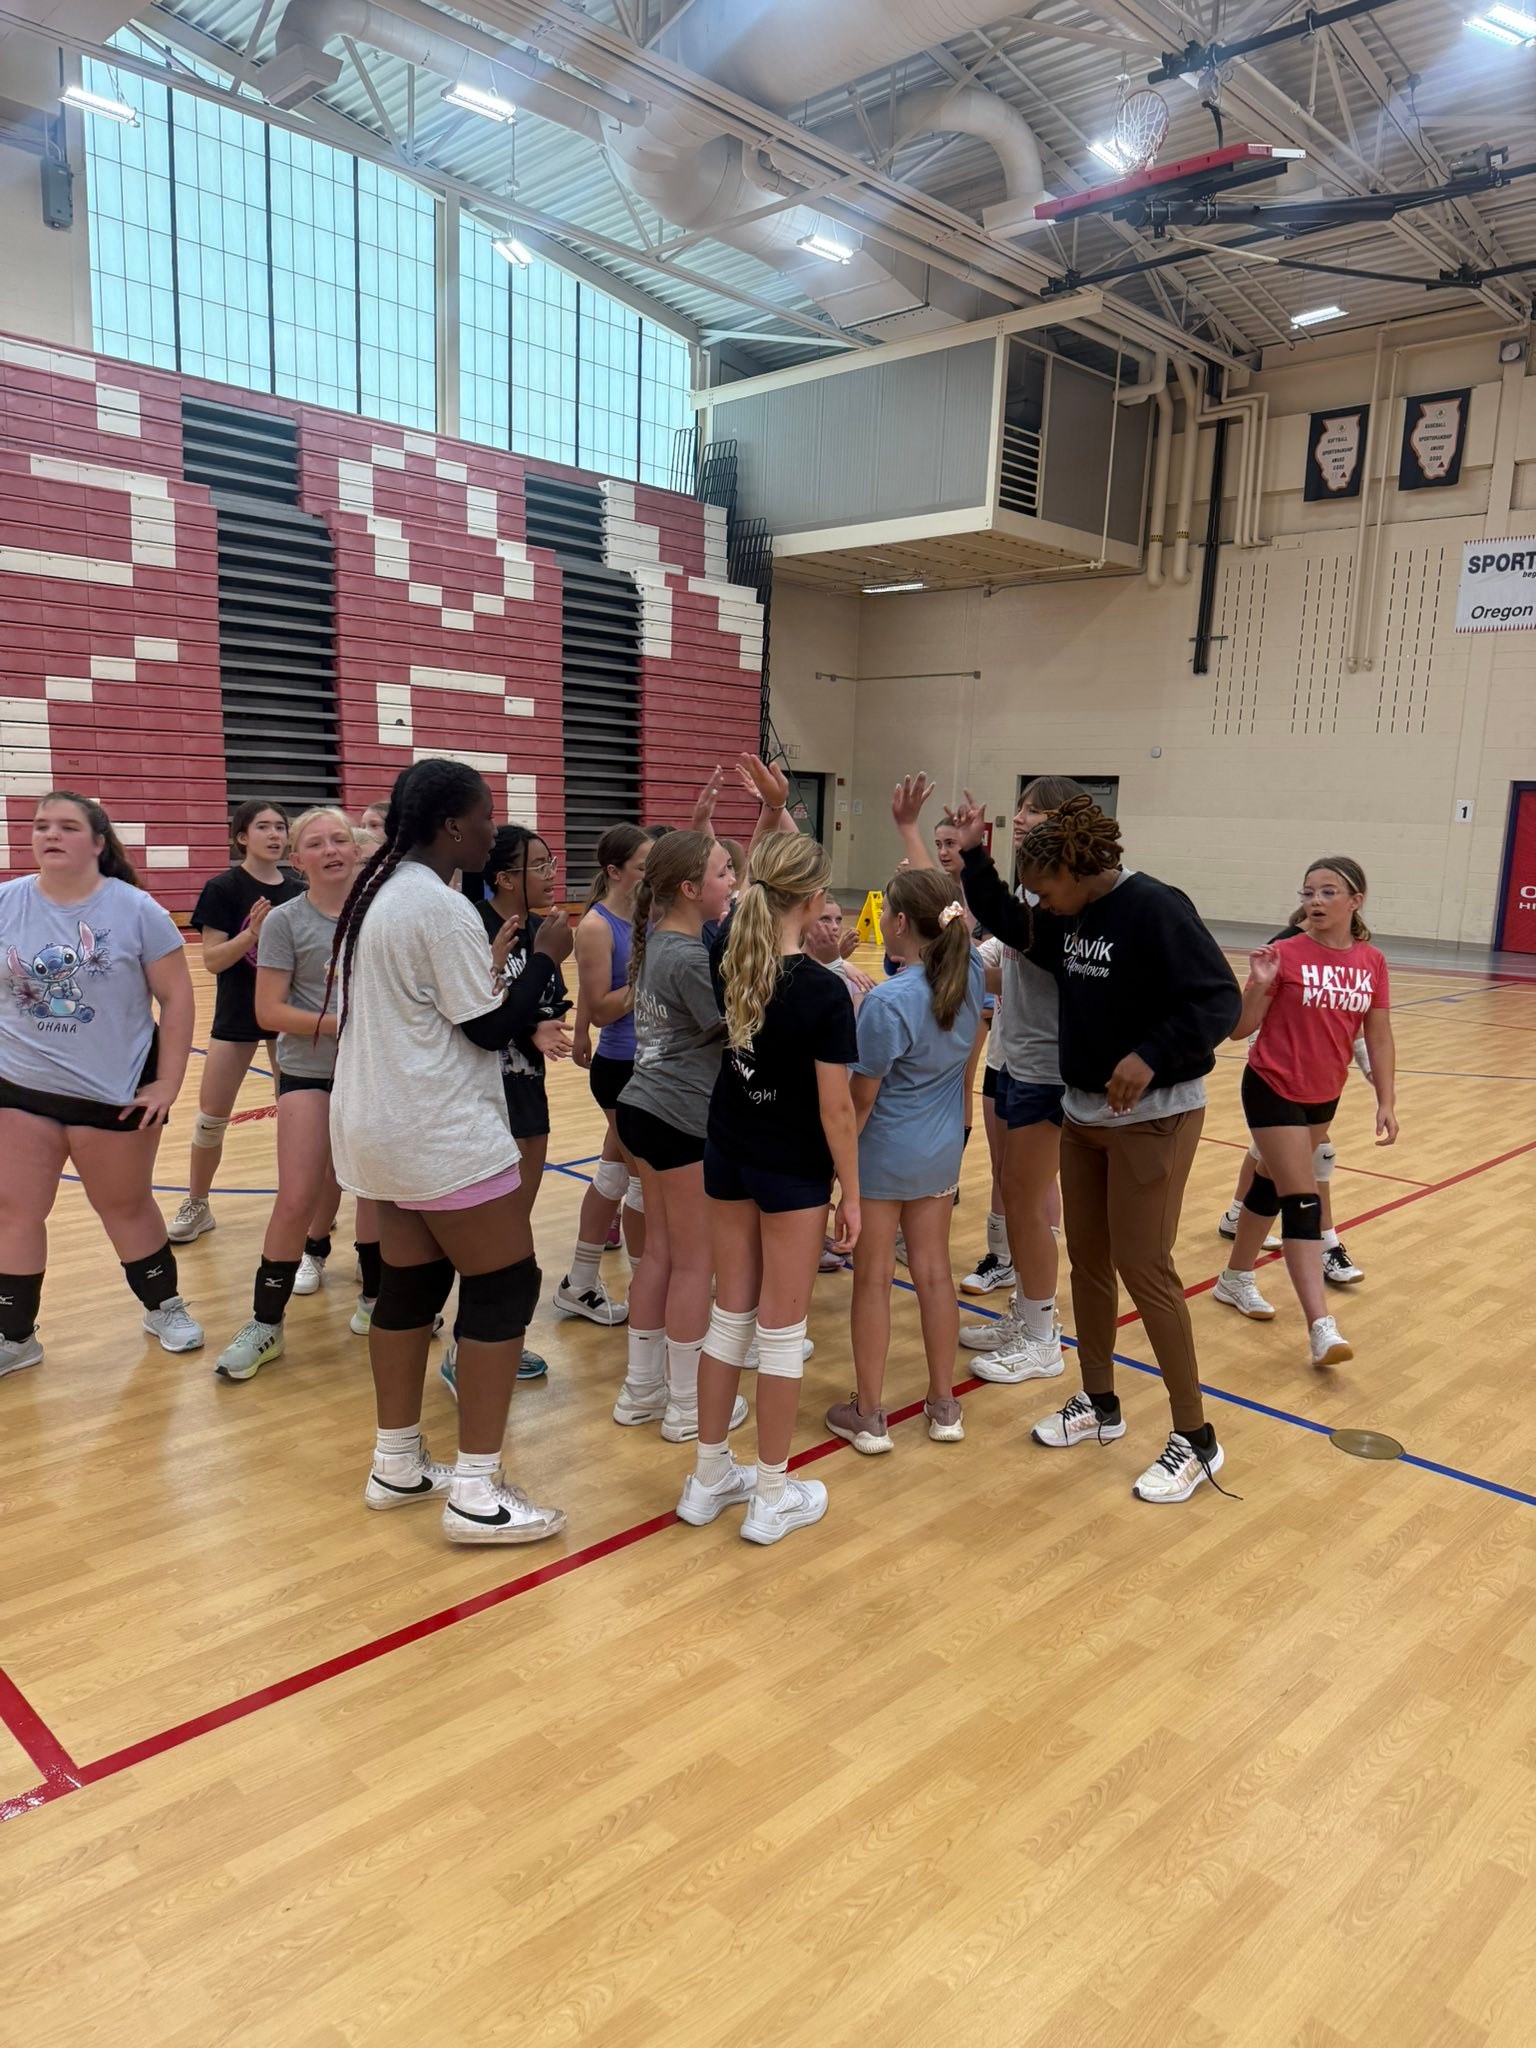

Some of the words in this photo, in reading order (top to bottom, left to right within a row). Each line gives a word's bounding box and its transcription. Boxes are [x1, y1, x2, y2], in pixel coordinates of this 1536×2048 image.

[1418, 434, 1453, 442] SPORTSMANSHIP
[1321, 446, 1354, 456] SPORTSMANSHIP
[1470, 605, 1533, 622] Oregon
[1461, 805, 1468, 819] 1
[1301, 964, 1373, 993] HAWK
[1302, 987, 1372, 1013] NATION
[37, 1021, 78, 1034] OHANA
